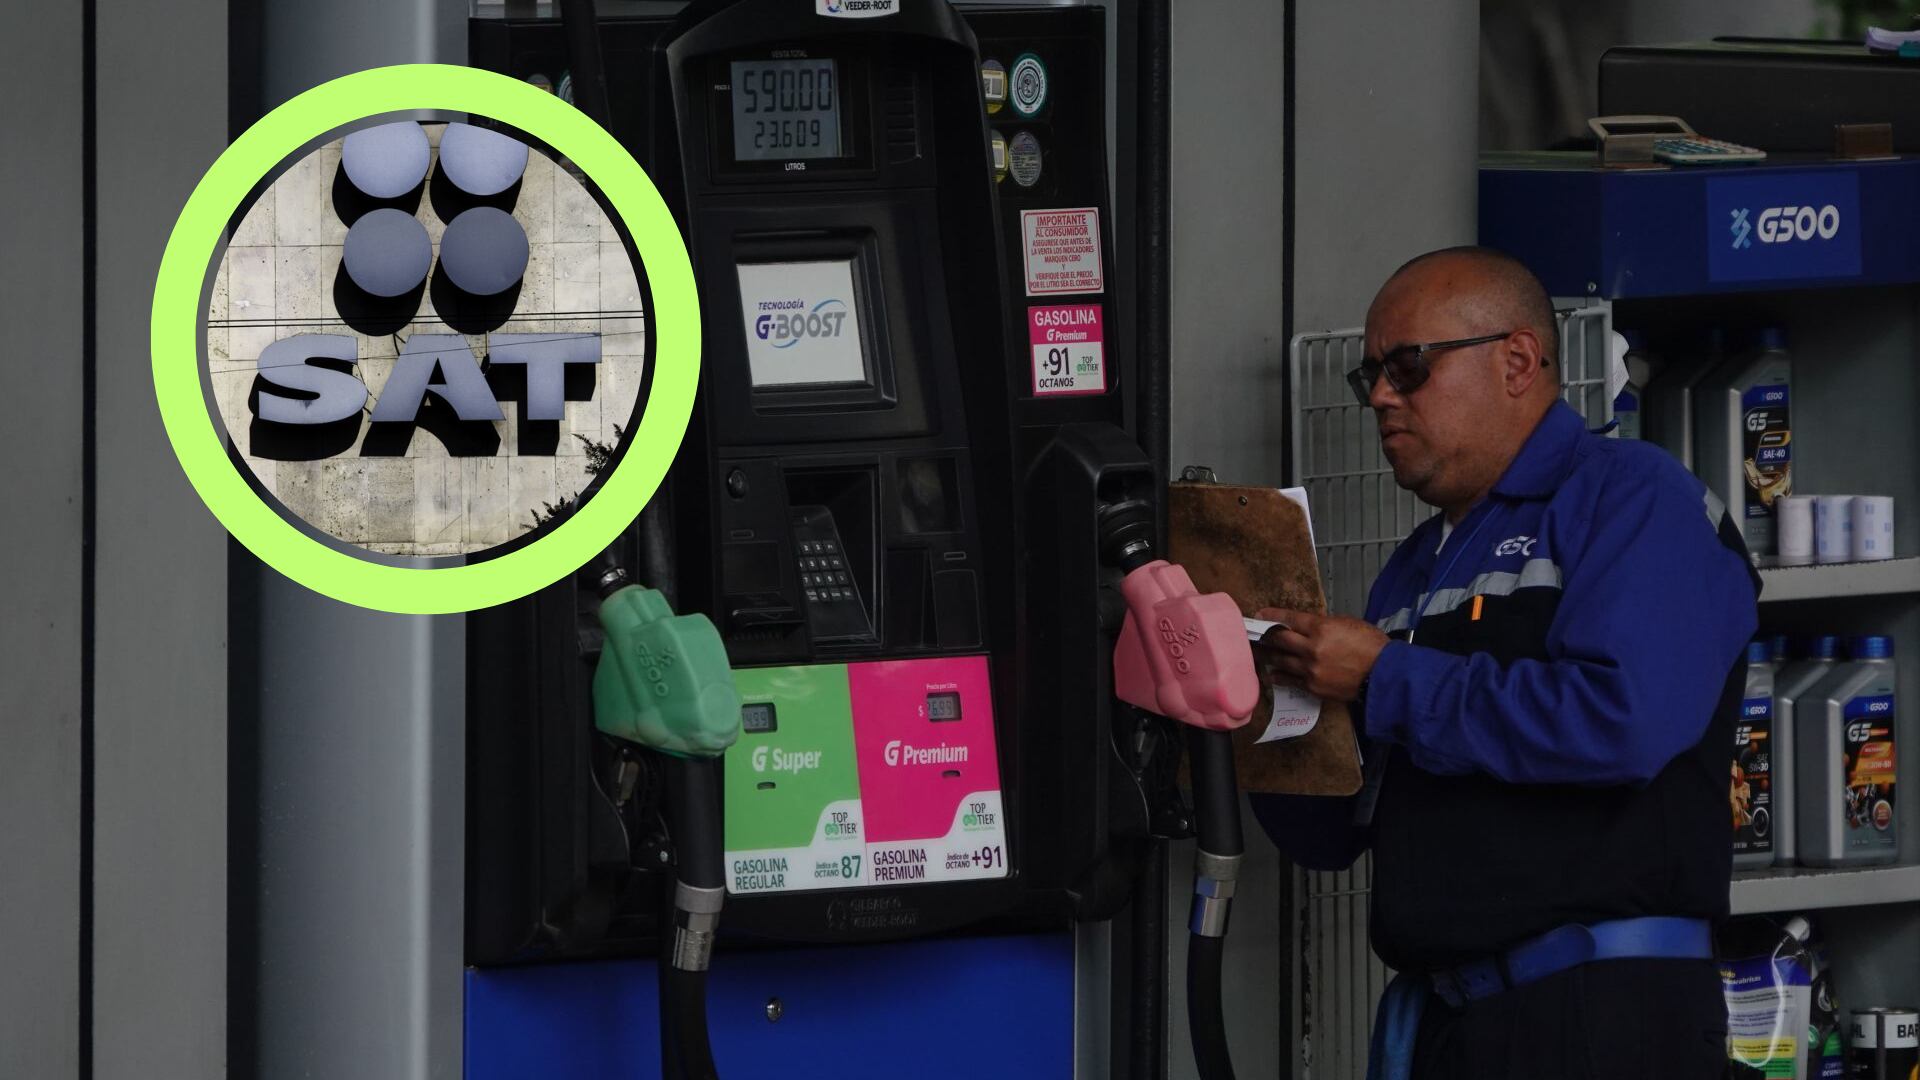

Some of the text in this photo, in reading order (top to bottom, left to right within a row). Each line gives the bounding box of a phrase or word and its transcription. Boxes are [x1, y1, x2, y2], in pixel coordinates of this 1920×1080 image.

[845, 1, 892, 11] VEEDER-ROOT
[755, 119, 821, 148] 23.609
[784, 163, 806, 171] LITROS
[1037, 215, 1087, 226] IMPORTANTE
[1757, 204, 1840, 243] G500
[1036, 227, 1088, 237] AL CONSUMIDOR
[1063, 246, 1094, 254] INDICADORES
[1036, 272, 1059, 280] VERIFIQUE
[1031, 281, 1040, 289] POR
[1077, 279, 1099, 287] CORRECTO
[758, 299, 804, 311] TECNOLOGÍA
[1035, 309, 1097, 326] GASOLINA
[1056, 330, 1087, 341] Premium
[1043, 347, 1070, 376] +91
[1081, 356, 1093, 364] TOP
[1087, 363, 1099, 371] TIER
[258, 332, 602, 425] SAT
[1039, 378, 1075, 388] OCTANOS
[1766, 392, 1783, 401] G500
[1747, 412, 1769, 431] G5
[1870, 703, 1889, 711] G500
[1277, 715, 1311, 727] Getnet
[1848, 723, 1873, 742] G5
[903, 742, 968, 766] Premium
[772, 748, 822, 775] Super
[970, 803, 986, 814] TOP
[832, 812, 848, 823] TOP
[977, 814, 995, 825] TIER
[840, 823, 858, 834] TIER
[873, 848, 927, 865] GASOLINA
[972, 845, 1002, 869] +91
[734, 857, 788, 875] GASOLINA
[840, 855, 861, 878] 87
[945, 861, 970, 870] OCTANO
[814, 869, 839, 878] OCTANO
[875, 865, 925, 881] PREMIUM
[735, 874, 785, 890] REGULAR
